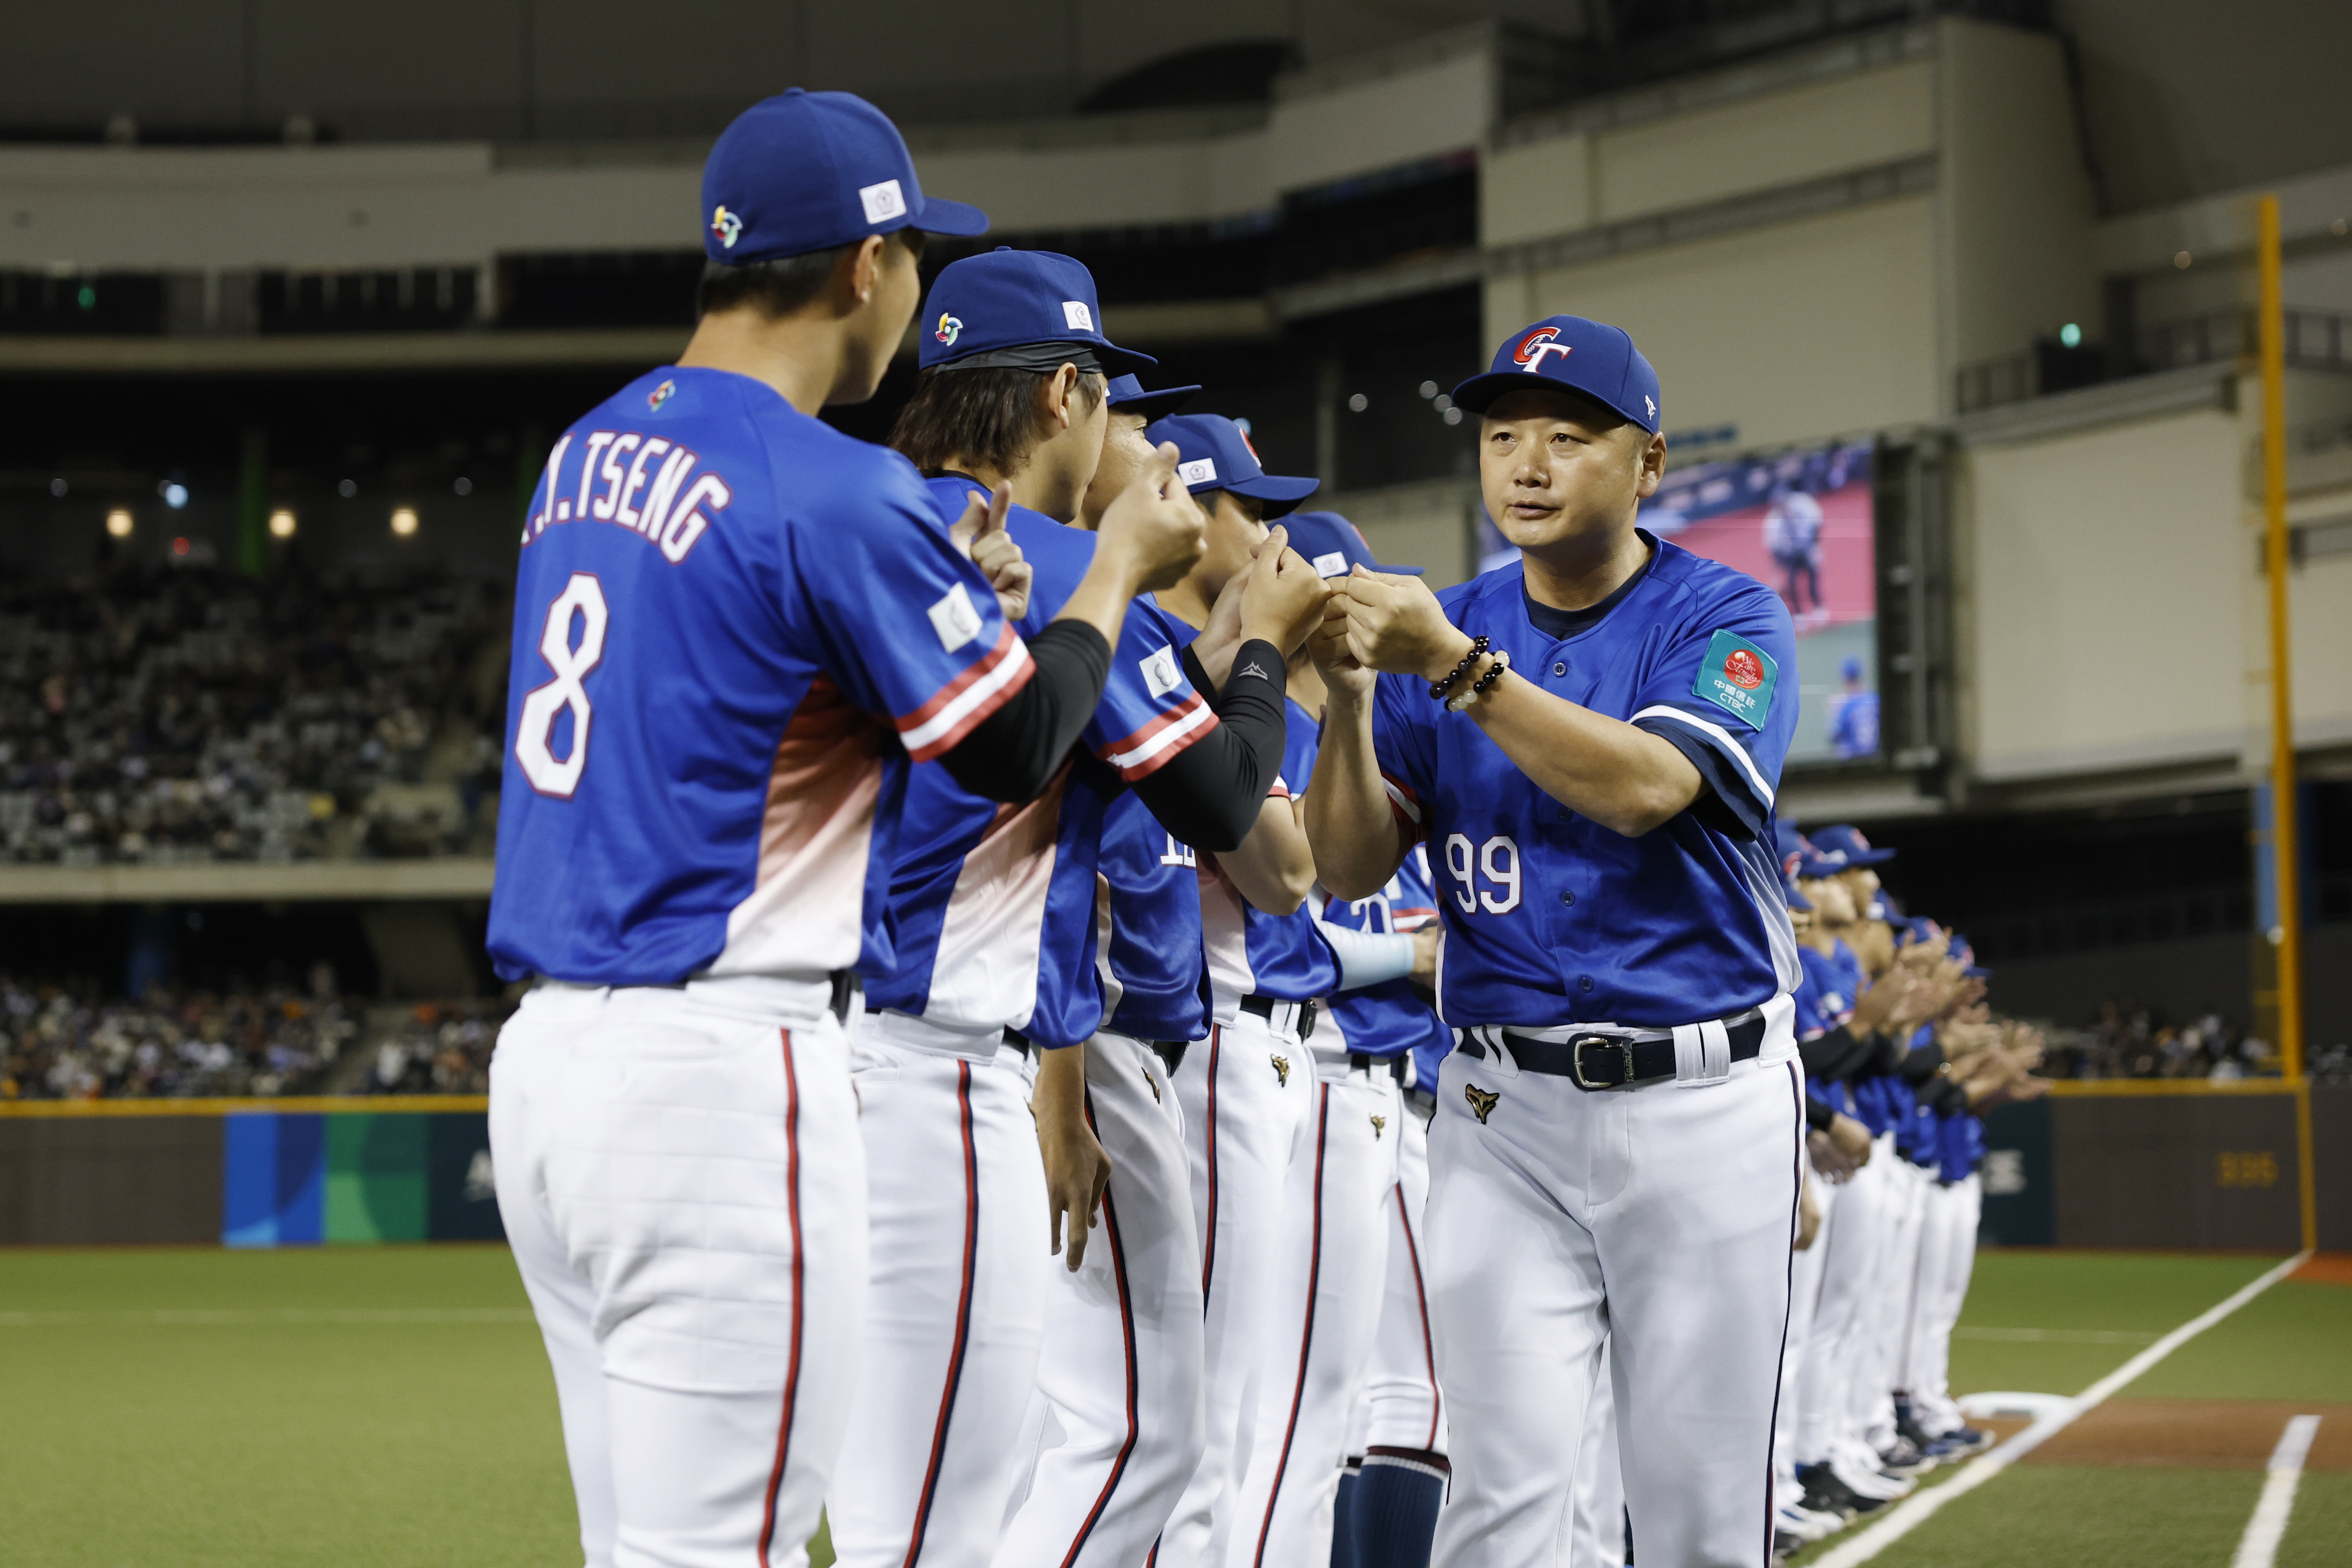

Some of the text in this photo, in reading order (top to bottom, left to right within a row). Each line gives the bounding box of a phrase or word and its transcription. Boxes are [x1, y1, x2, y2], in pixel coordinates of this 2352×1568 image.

[1513, 326, 1572, 373] CT
[1726, 660, 1761, 684] Family
[1742, 655, 1755, 666] We
[514, 571, 609, 802] 8
[1714, 679, 1756, 709] 中國信託
[1720, 693, 1746, 713] CTBC
[1445, 833, 1522, 915] 99
